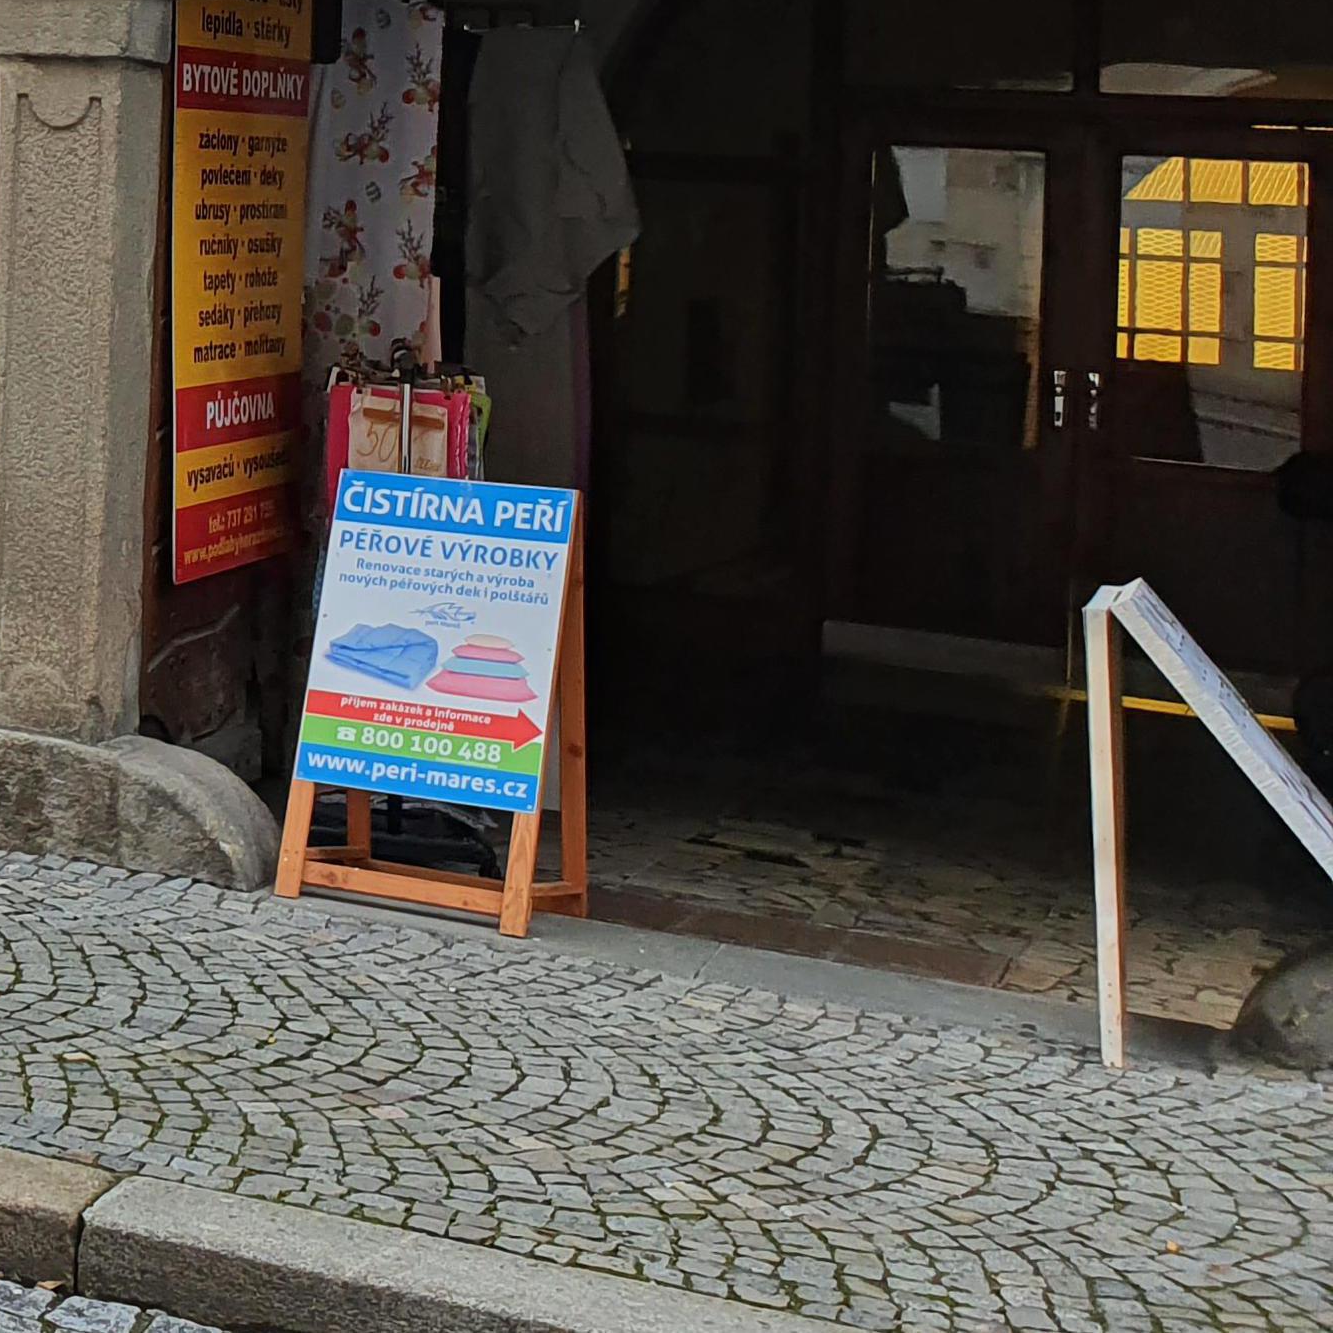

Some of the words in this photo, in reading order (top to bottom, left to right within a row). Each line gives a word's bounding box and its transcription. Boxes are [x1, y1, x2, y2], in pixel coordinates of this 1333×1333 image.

[201, 6, 243, 40] lepidla
[182, 61, 239, 95] BYTOVÉ
[242, 67, 304, 101] DOPLŇKY
[198, 127, 240, 157] záclony
[259, 164, 285, 190] deky
[195, 197, 231, 225] ubrusy
[199, 232, 239, 260] ručníky
[247, 231, 283, 257] osušky
[203, 268, 237, 296] tapety
[244, 266, 278, 288] rohože
[198, 302, 235, 330] sedáky
[194, 340, 236, 363] matrace
[206, 390, 274, 430] PŮJČOVNA
[186, 453, 235, 492] vysavačů
[343, 480, 485, 526] ČISTÍRNA
[493, 498, 569, 533] PEŘÍ
[339, 528, 433, 558] PÉŘOVÉ
[440, 539, 559, 572] VÝROBKY
[339, 572, 393, 588] nových
[389, 576, 453, 596] péřových
[456, 584, 482, 598] dek
[483, 585, 488, 598] i
[489, 586, 550, 606] polštářů
[356, 557, 421, 577] Renovace
[424, 566, 474, 584] starých
[476, 574, 484, 583] a
[486, 572, 535, 589] výroba
[340, 696, 377, 710] příjem
[379, 700, 423, 716] zakázek
[425, 708, 432, 716] a
[434, 706, 491, 725] informace
[373, 711, 393, 723] zde
[395, 716, 402, 725] v
[404, 715, 454, 732] prodejně
[360, 726, 404, 749] 800
[410, 734, 453, 756] 100
[458, 741, 501, 764] 488
[307, 750, 529, 799] www.peri-mares.cz
